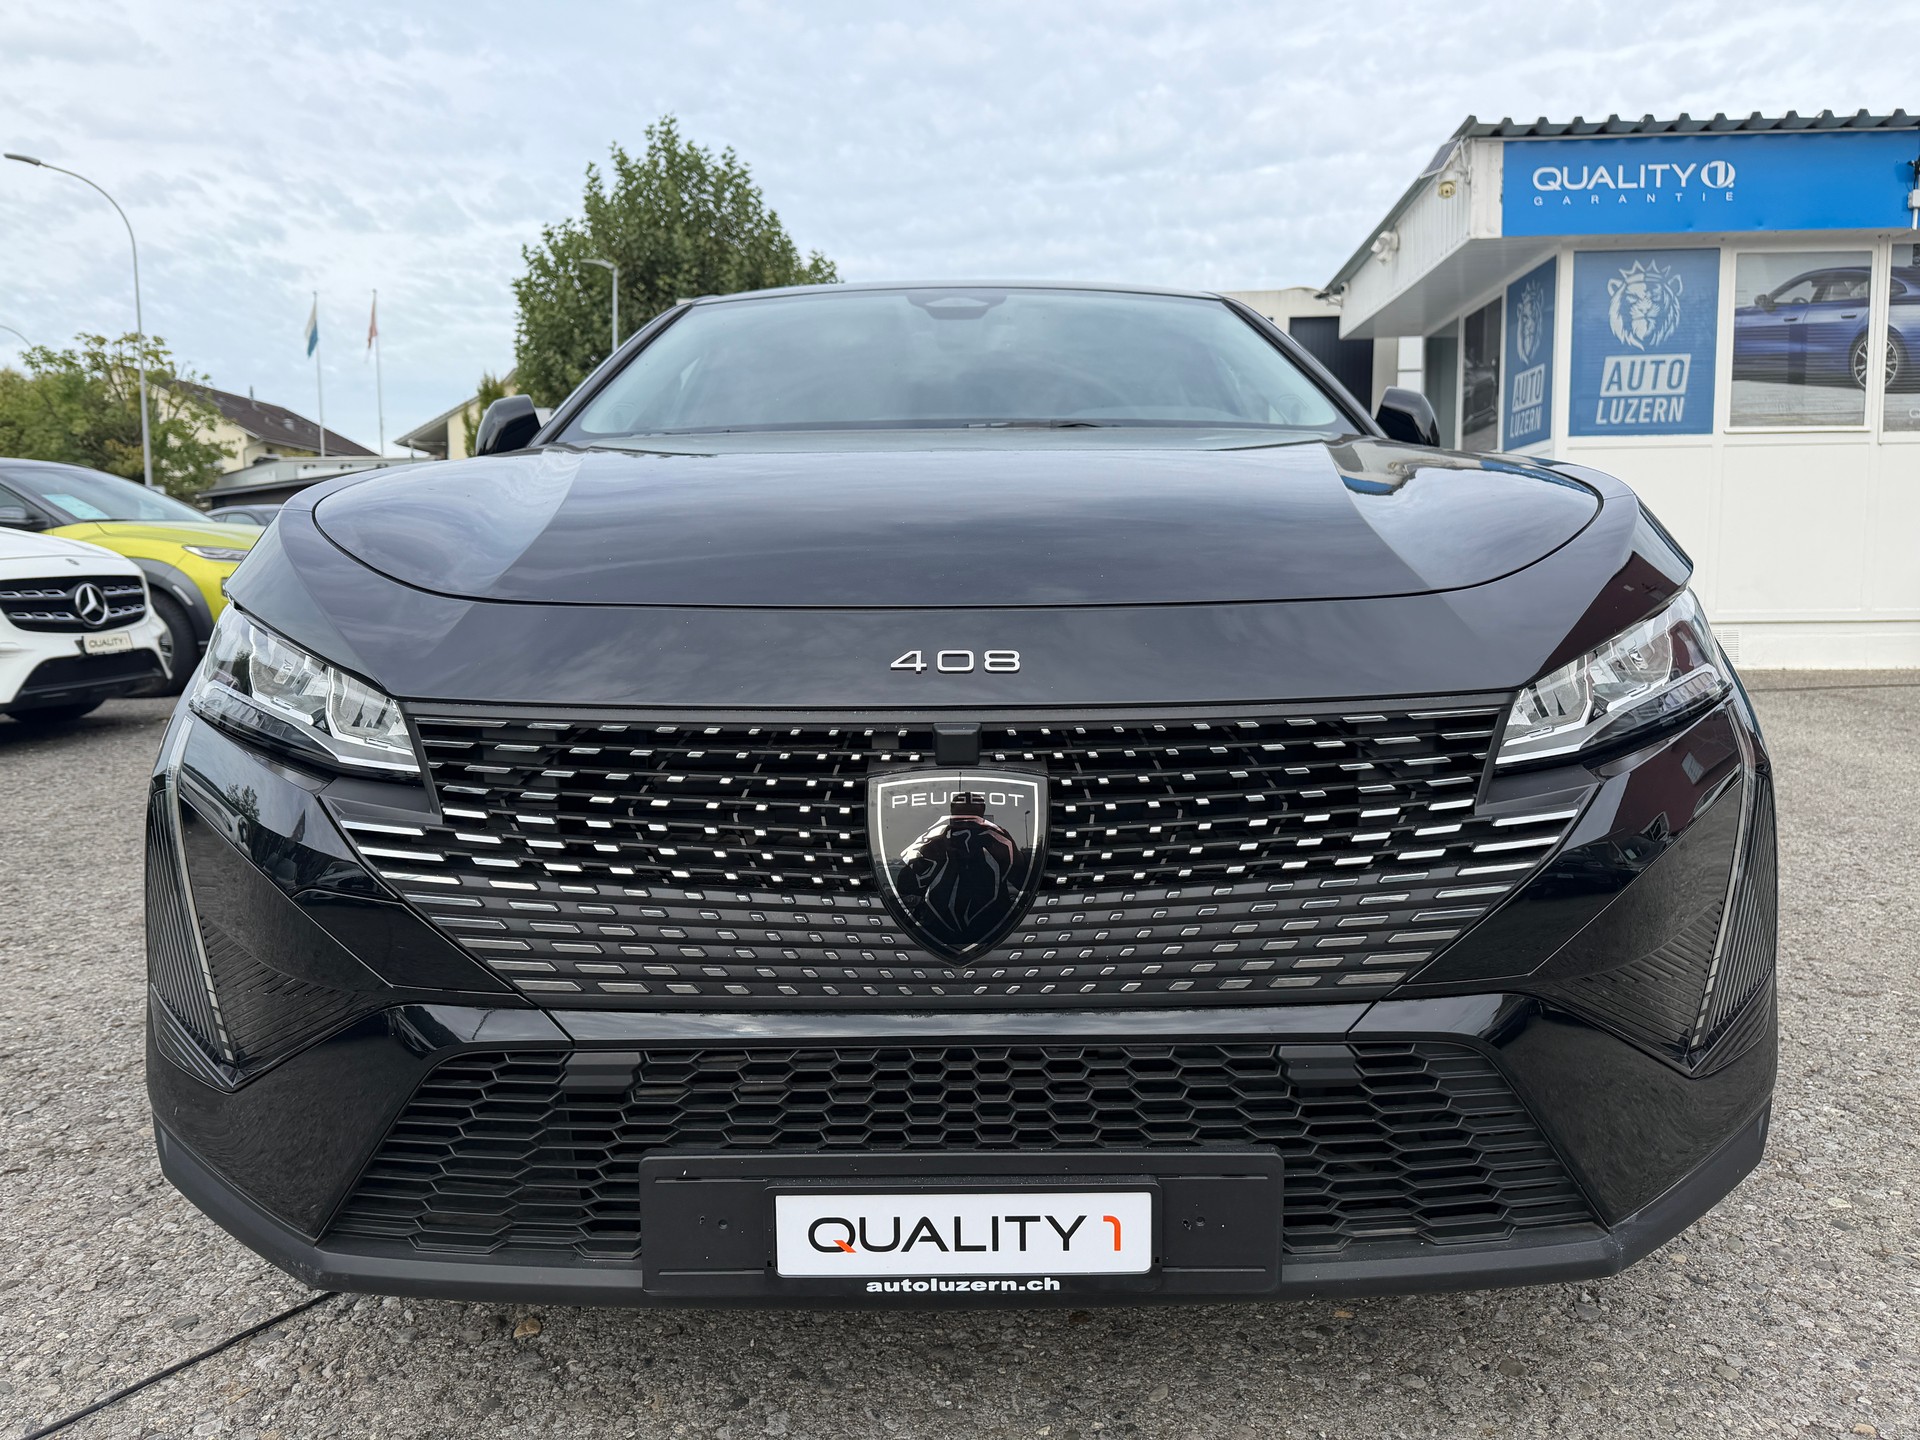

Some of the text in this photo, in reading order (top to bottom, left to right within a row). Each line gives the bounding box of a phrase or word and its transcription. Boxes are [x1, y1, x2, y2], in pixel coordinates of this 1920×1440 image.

[1532, 163, 1698, 191] QUALITY
[1533, 191, 1734, 207] GARANTIE
[1513, 368, 1543, 408] AUTO
[1605, 359, 1685, 392] AUTO
[1509, 405, 1543, 439] LUZERN
[1595, 396, 1685, 425] LUZERN
[890, 649, 1021, 673] 408
[891, 791, 1025, 809] PEUGEOT
[808, 1214, 1122, 1254] QUALITY 1
[866, 1277, 1061, 1293] autoluzern.ch
